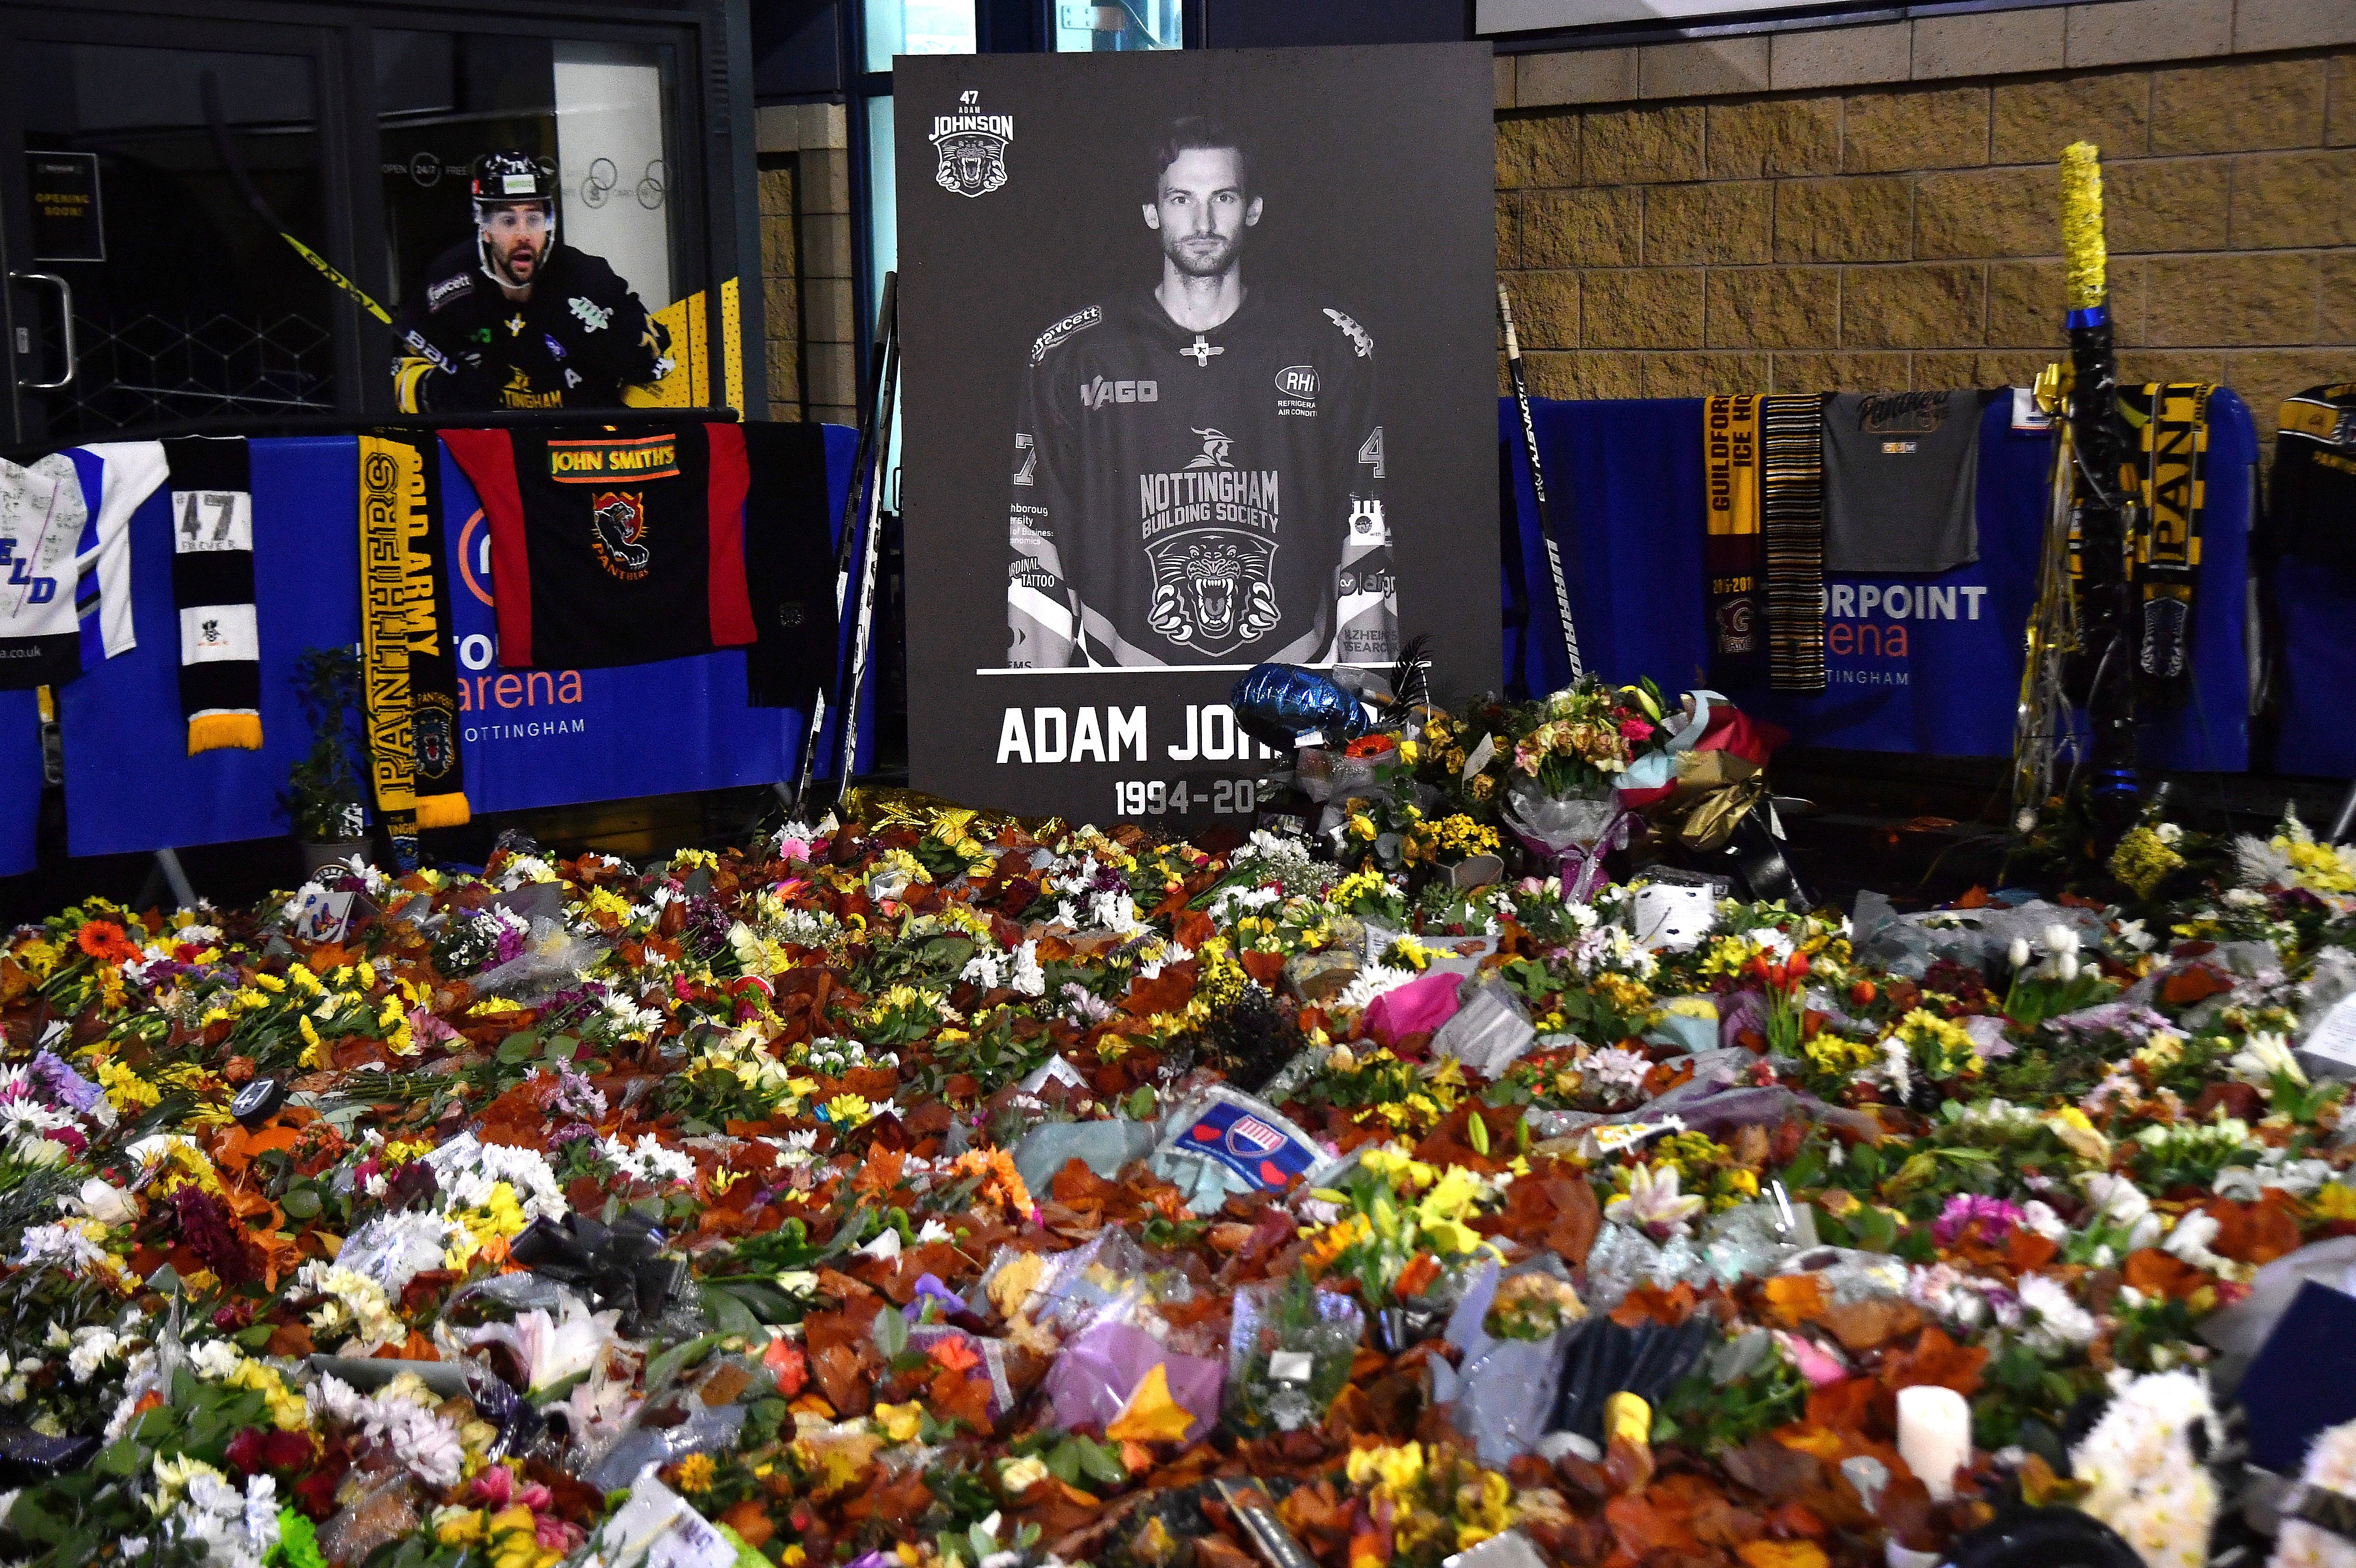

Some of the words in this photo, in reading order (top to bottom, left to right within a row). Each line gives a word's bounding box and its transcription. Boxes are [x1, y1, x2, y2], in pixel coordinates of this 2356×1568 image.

[960, 90, 979, 104] 47
[928, 115, 1014, 141] JOHNSON
[564, 367, 583, 389] A
[1287, 372, 1315, 392] RHI
[1277, 400, 1316, 409] REFRIGERA
[552, 451, 602, 474] JOHN
[1014, 433, 1037, 486] 7
[1358, 426, 1385, 479] 4
[1733, 432, 1752, 467] ICE
[1140, 470, 1278, 519] NOTTINGHAM
[1143, 503, 1211, 539] BUILDING
[1216, 503, 1278, 534] SOCIETY
[1021, 574, 1055, 588] TATTOO
[1822, 622, 1909, 657] ena
[996, 705, 1148, 764] ADAM
[233, 1079, 274, 1109] 47
